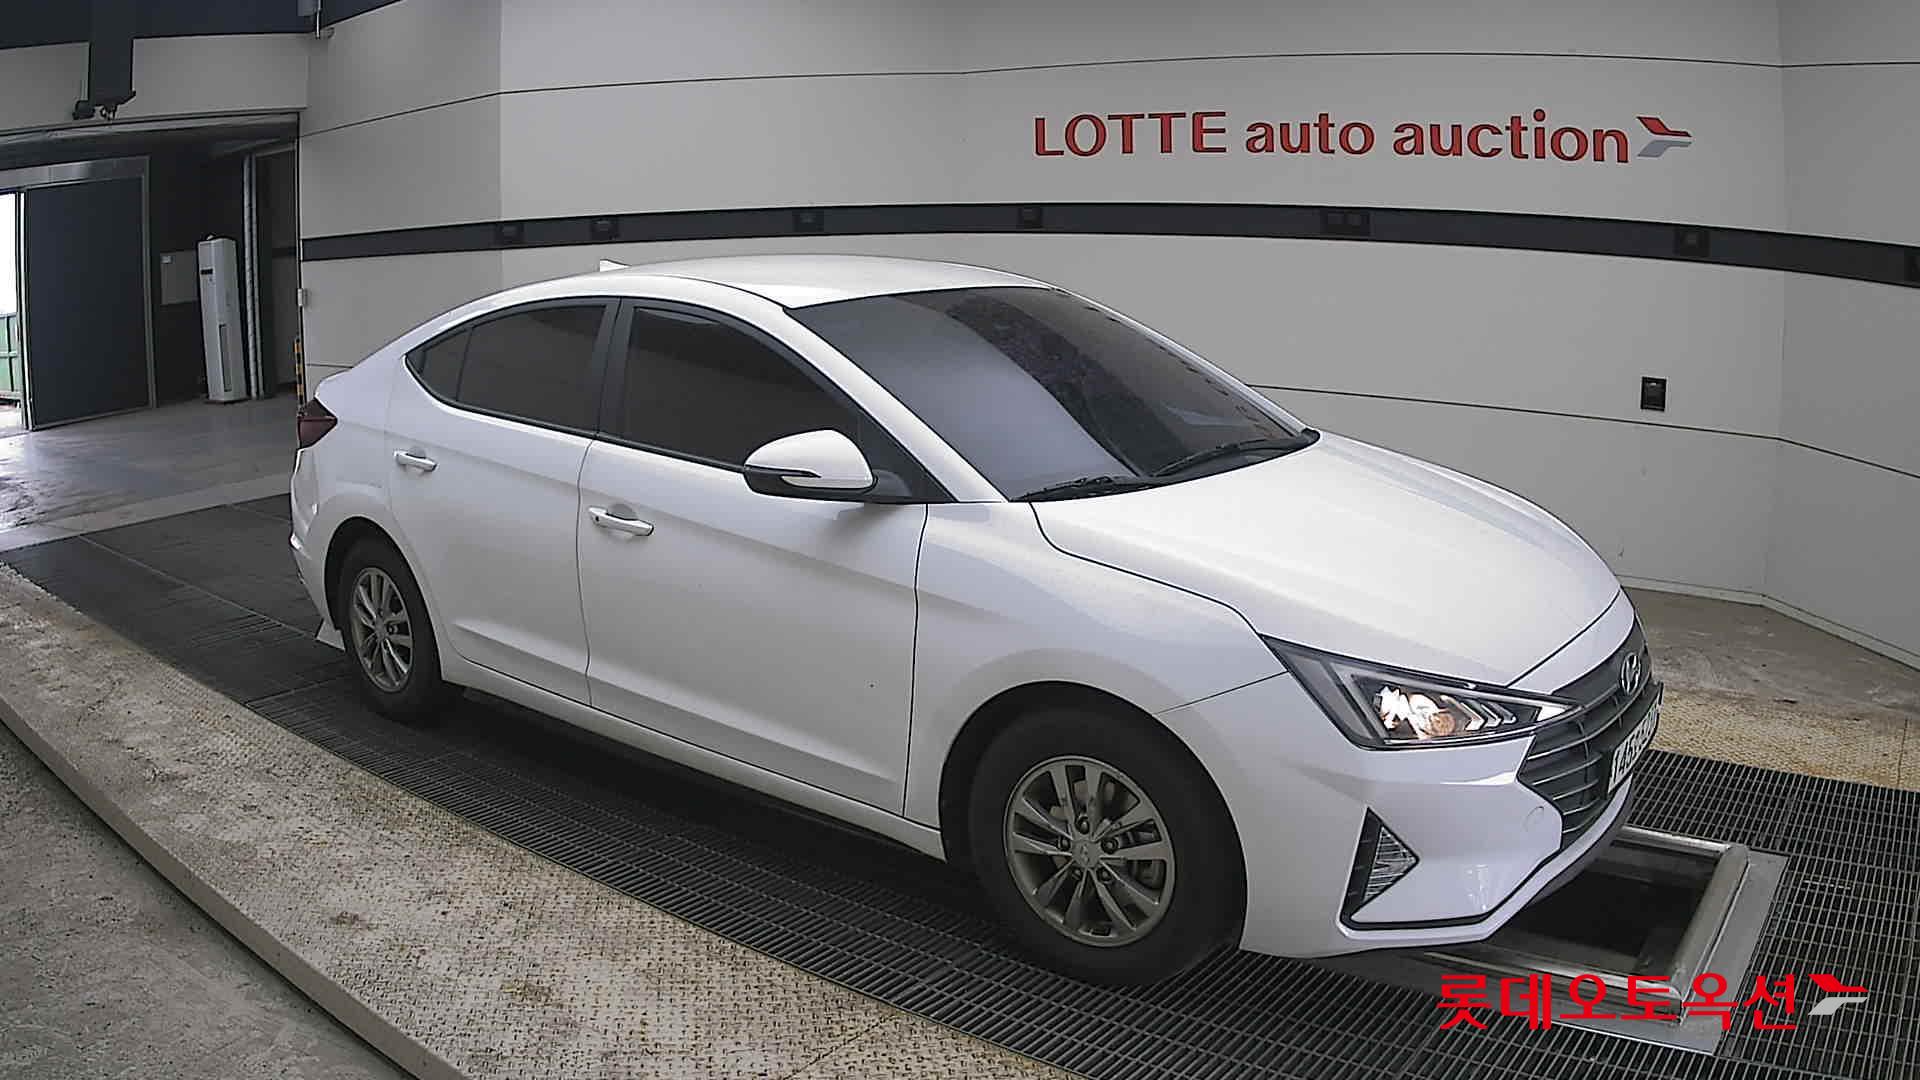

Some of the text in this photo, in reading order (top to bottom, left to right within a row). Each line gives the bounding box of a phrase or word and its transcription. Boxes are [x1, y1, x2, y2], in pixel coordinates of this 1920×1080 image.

[1033, 108, 1629, 163] LOTTE auto auction
